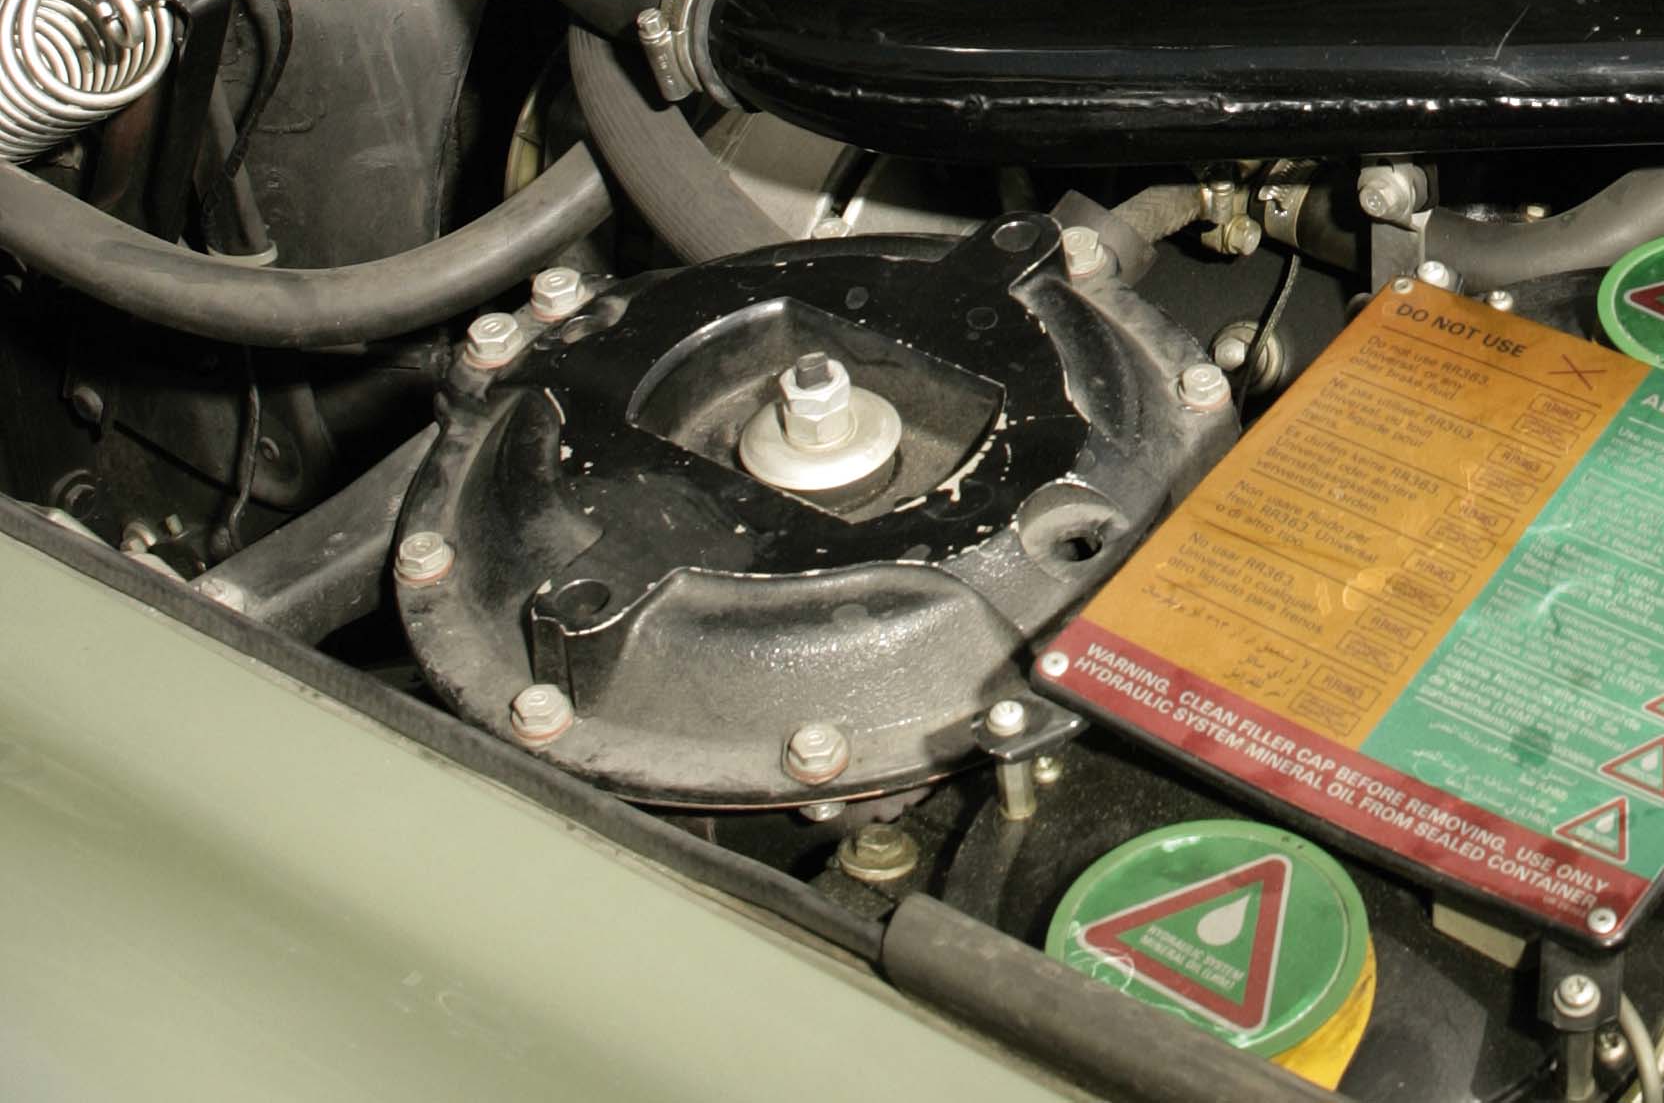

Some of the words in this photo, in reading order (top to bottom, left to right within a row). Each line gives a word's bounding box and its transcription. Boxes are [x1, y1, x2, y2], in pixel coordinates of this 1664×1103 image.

[1394, 303, 1430, 322] DO
[1430, 315, 1480, 340] NOT
[1481, 333, 1527, 357] USE
[1071, 657, 1175, 712] HYDRAULIC
[1170, 708, 1245, 749] SYSTEM
[1243, 743, 1327, 789] MINERAL
[1325, 782, 1358, 804] OIL
[1358, 797, 1414, 829] FROM
[1415, 822, 1486, 861] SEALED
[1486, 852, 1596, 910] CONTAINER
[1177, 690, 1239, 726] CLEAN
[1237, 720, 1296, 753] FILLER
[1295, 747, 1337, 773] CAP
[1334, 766, 1405, 805] BEFORE
[1515, 846, 1554, 871] USE
[1555, 863, 1608, 895] ONLY
[1141, 935, 1184, 965] MINERAL
[1185, 960, 1201, 974] OIL
[1147, 925, 1205, 960] HYDRAULIC
[1203, 955, 1245, 982] SYSTEM
